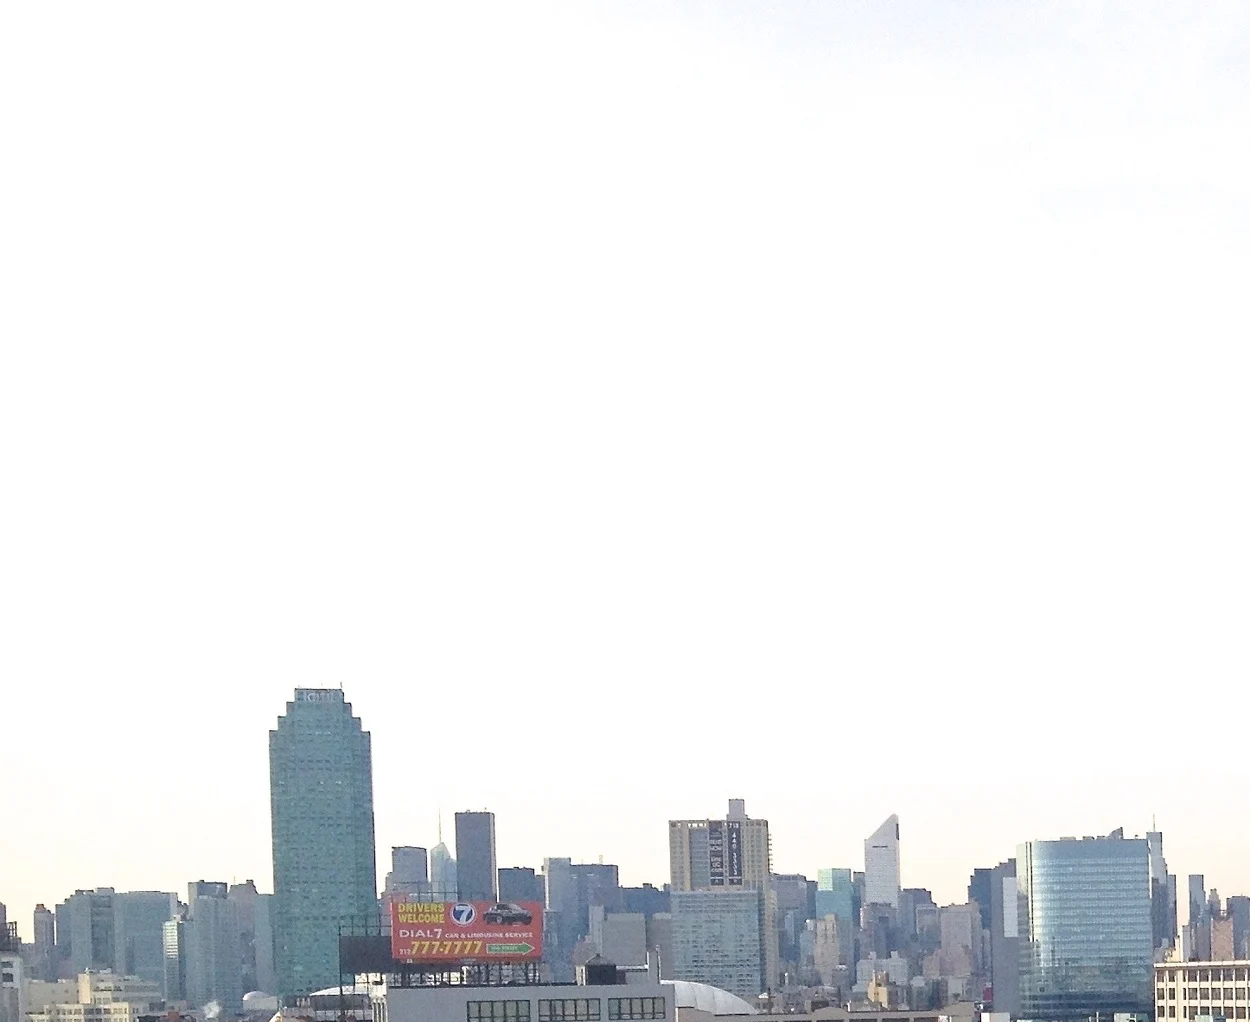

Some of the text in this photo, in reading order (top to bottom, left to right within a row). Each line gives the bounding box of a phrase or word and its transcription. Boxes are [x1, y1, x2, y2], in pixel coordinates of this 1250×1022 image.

[398, 903, 445, 913] DRIVERS
[398, 913, 445, 924] WELCOME
[455, 905, 470, 923] 7
